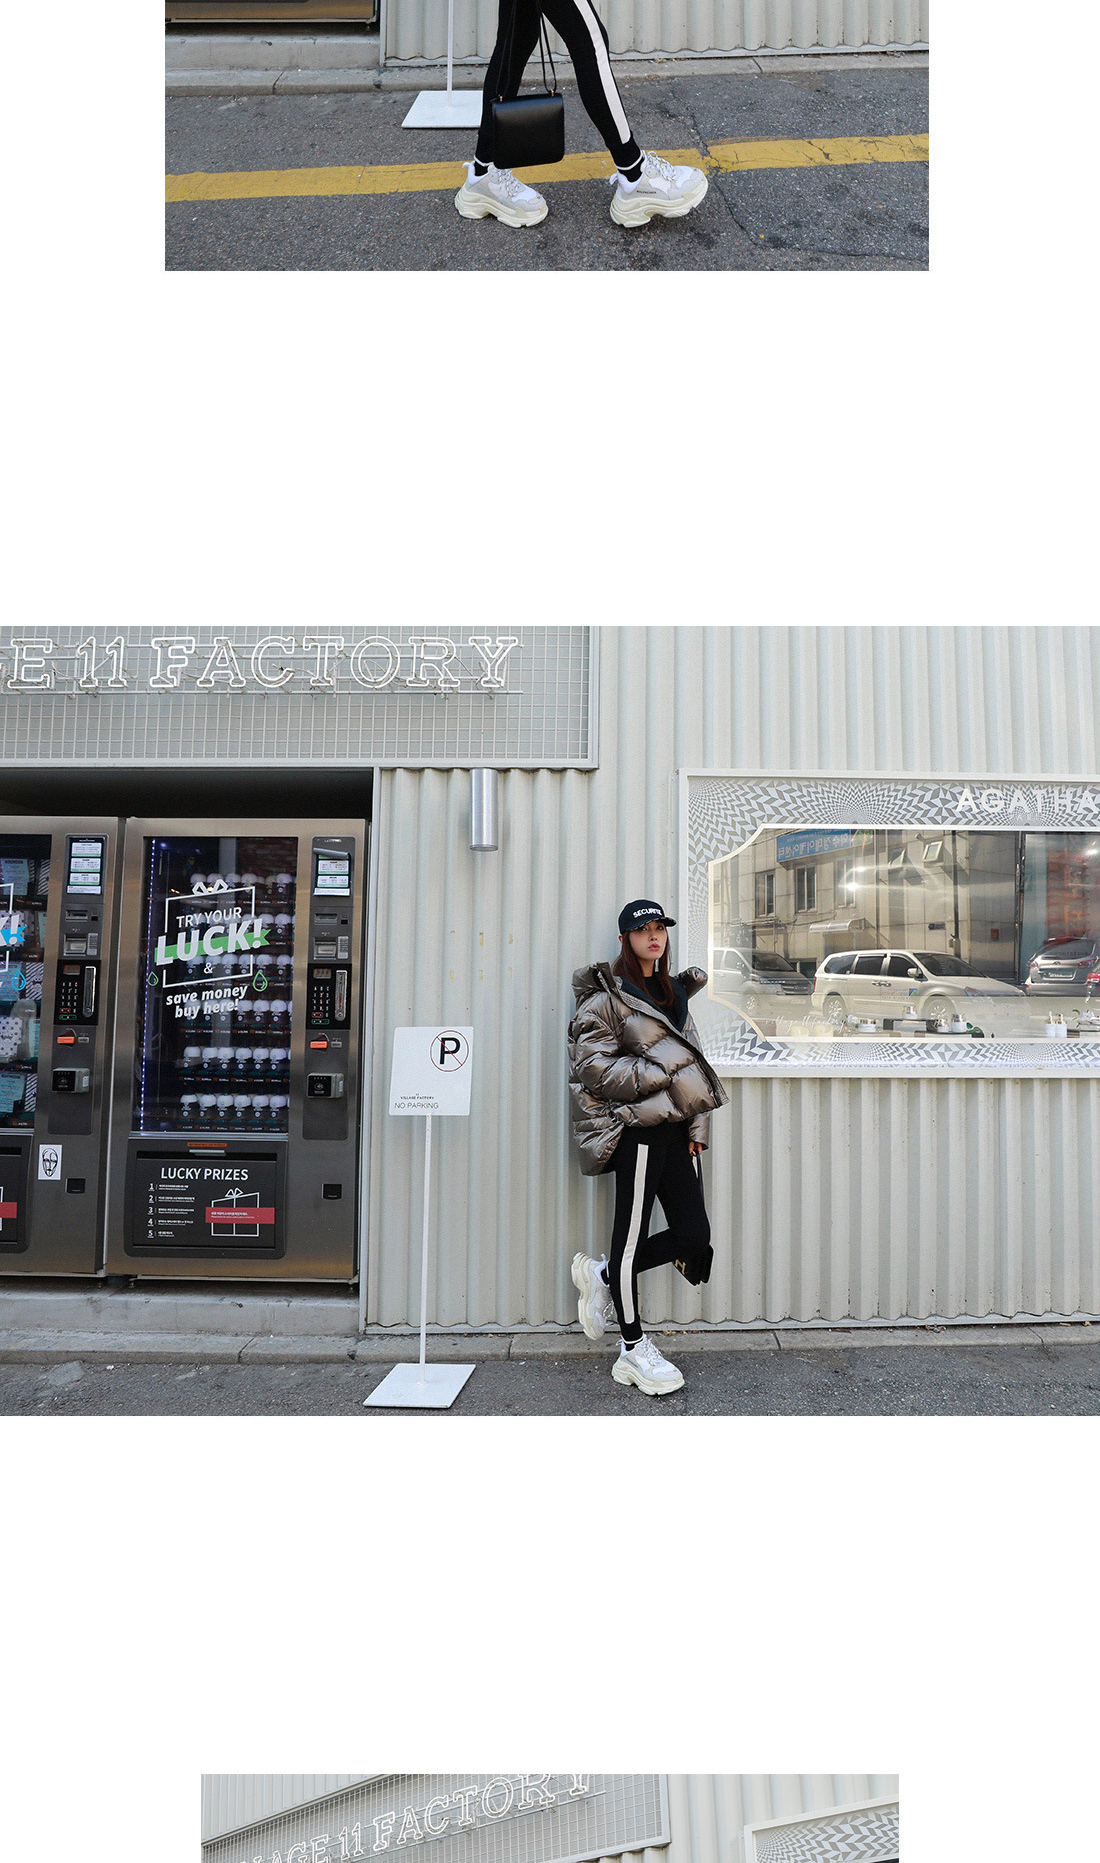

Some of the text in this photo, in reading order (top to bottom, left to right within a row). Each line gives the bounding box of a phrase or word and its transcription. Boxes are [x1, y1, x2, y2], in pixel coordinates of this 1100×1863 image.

[78, 637, 128, 688] 11
[150, 636, 518, 688] FACTORY
[956, 788, 1099, 814] AGATHA
[176, 907, 242, 928] TRY YOUR
[156, 918, 263, 966] LUCK!
[203, 962, 213, 974] &
[166, 986, 248, 1005] save money
[175, 998, 239, 1019] buy here!
[161, 1167, 249, 1181] LUCKY PRIZES
[339, 1822, 363, 1860] 11
